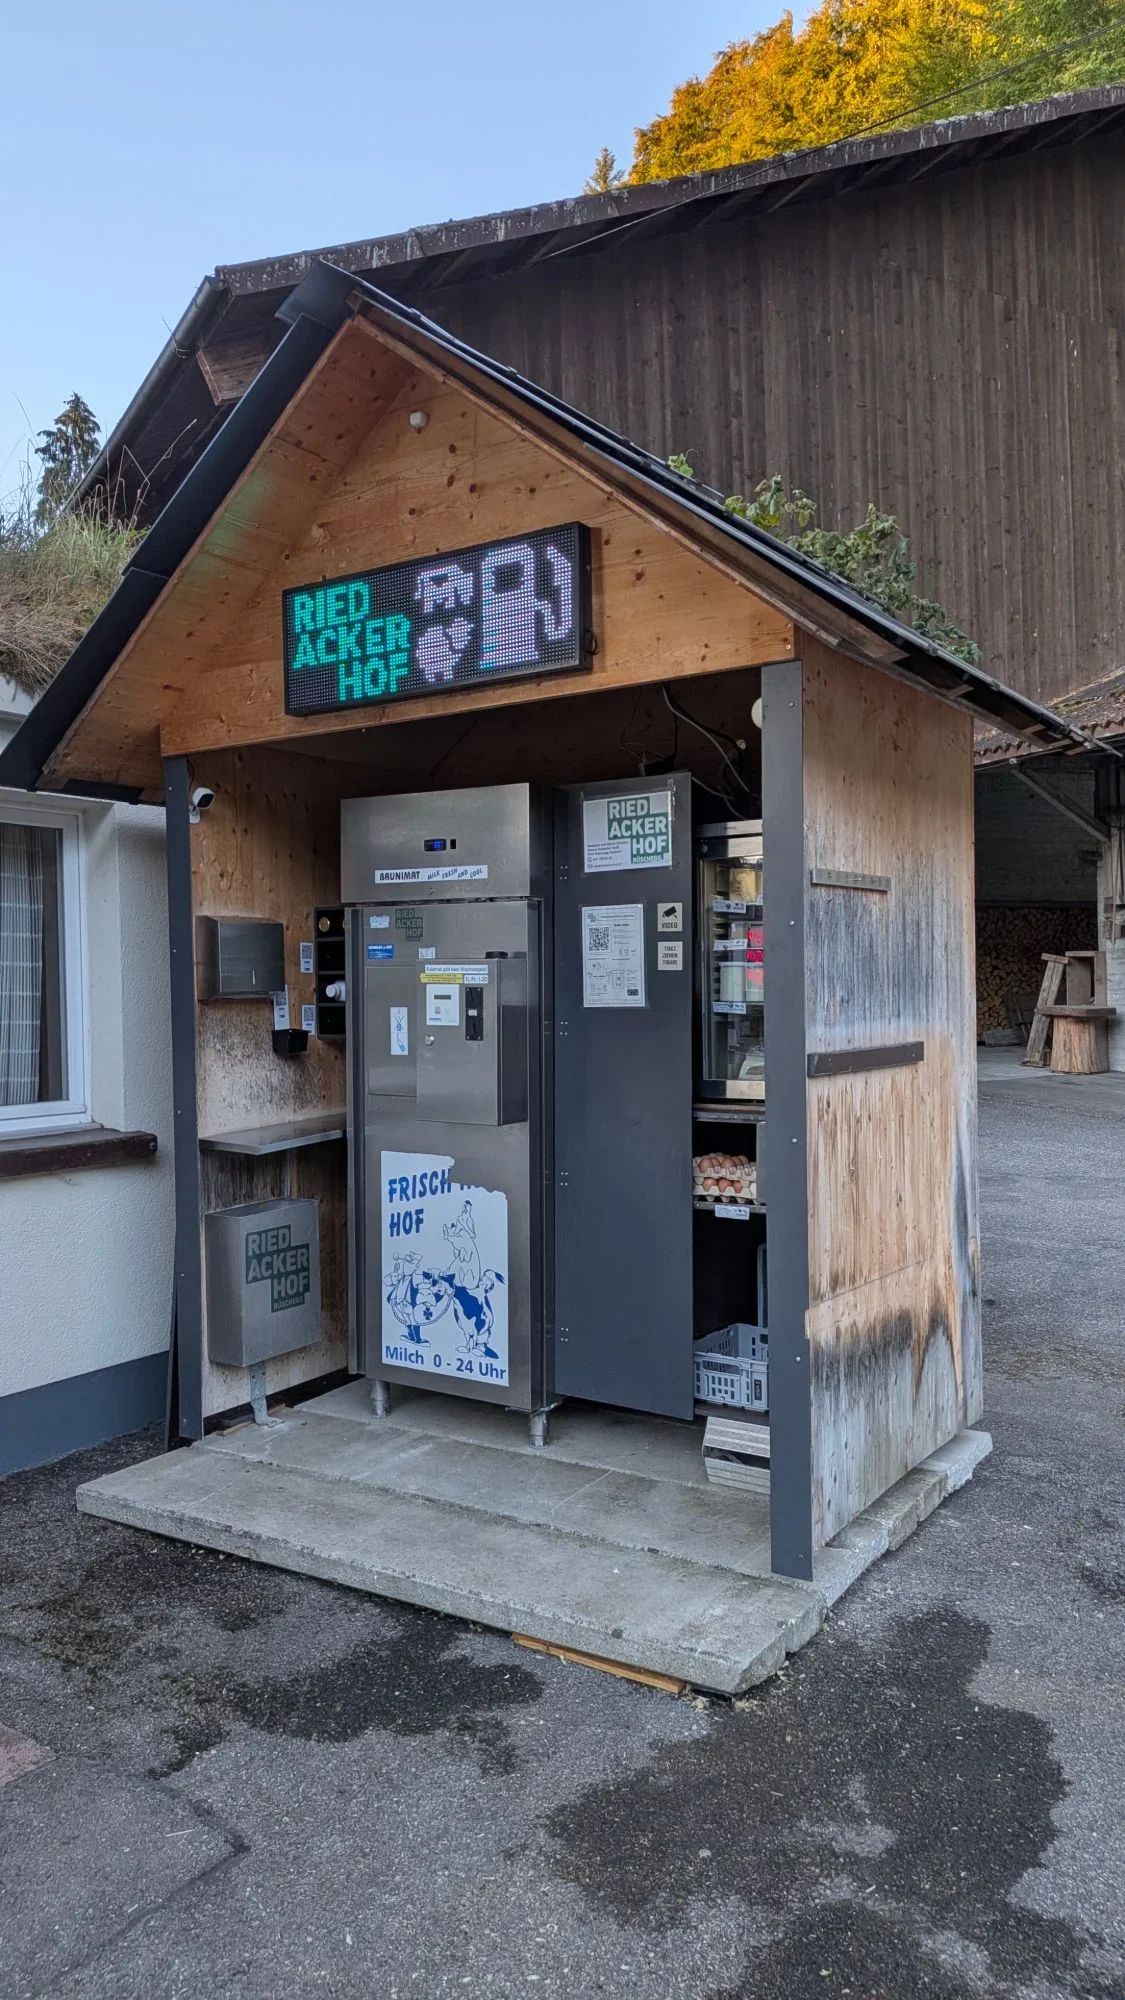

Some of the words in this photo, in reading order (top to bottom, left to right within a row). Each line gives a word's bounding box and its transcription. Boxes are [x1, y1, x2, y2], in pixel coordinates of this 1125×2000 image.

[292, 580, 370, 633] RIED
[292, 613, 412, 670] ACKER
[337, 652, 410, 701] HOF
[609, 799, 648, 819] RIED
[609, 816, 667, 838] ACKER
[632, 836, 667, 854] HOF
[379, 871, 420, 881] BRUNIMAT
[427, 870, 441, 880] MILK
[441, 868, 458, 879] FRESH
[458, 870, 468, 878] AND
[469, 868, 484, 878] COOL
[396, 909, 414, 918] RIED
[396, 918, 422, 928] ACKER
[406, 928, 422, 937] HOF
[388, 1168, 452, 1203] FRISCH
[389, 1208, 424, 1237] HOF
[248, 1228, 290, 1257] RIED
[248, 1248, 309, 1282] ACKER
[273, 1272, 309, 1299] HOF
[385, 1345, 424, 1366] Milch
[433, 1353, 442, 1368] 0
[456, 1358, 474, 1375] 24
[479, 1363, 506, 1380] Uhr
